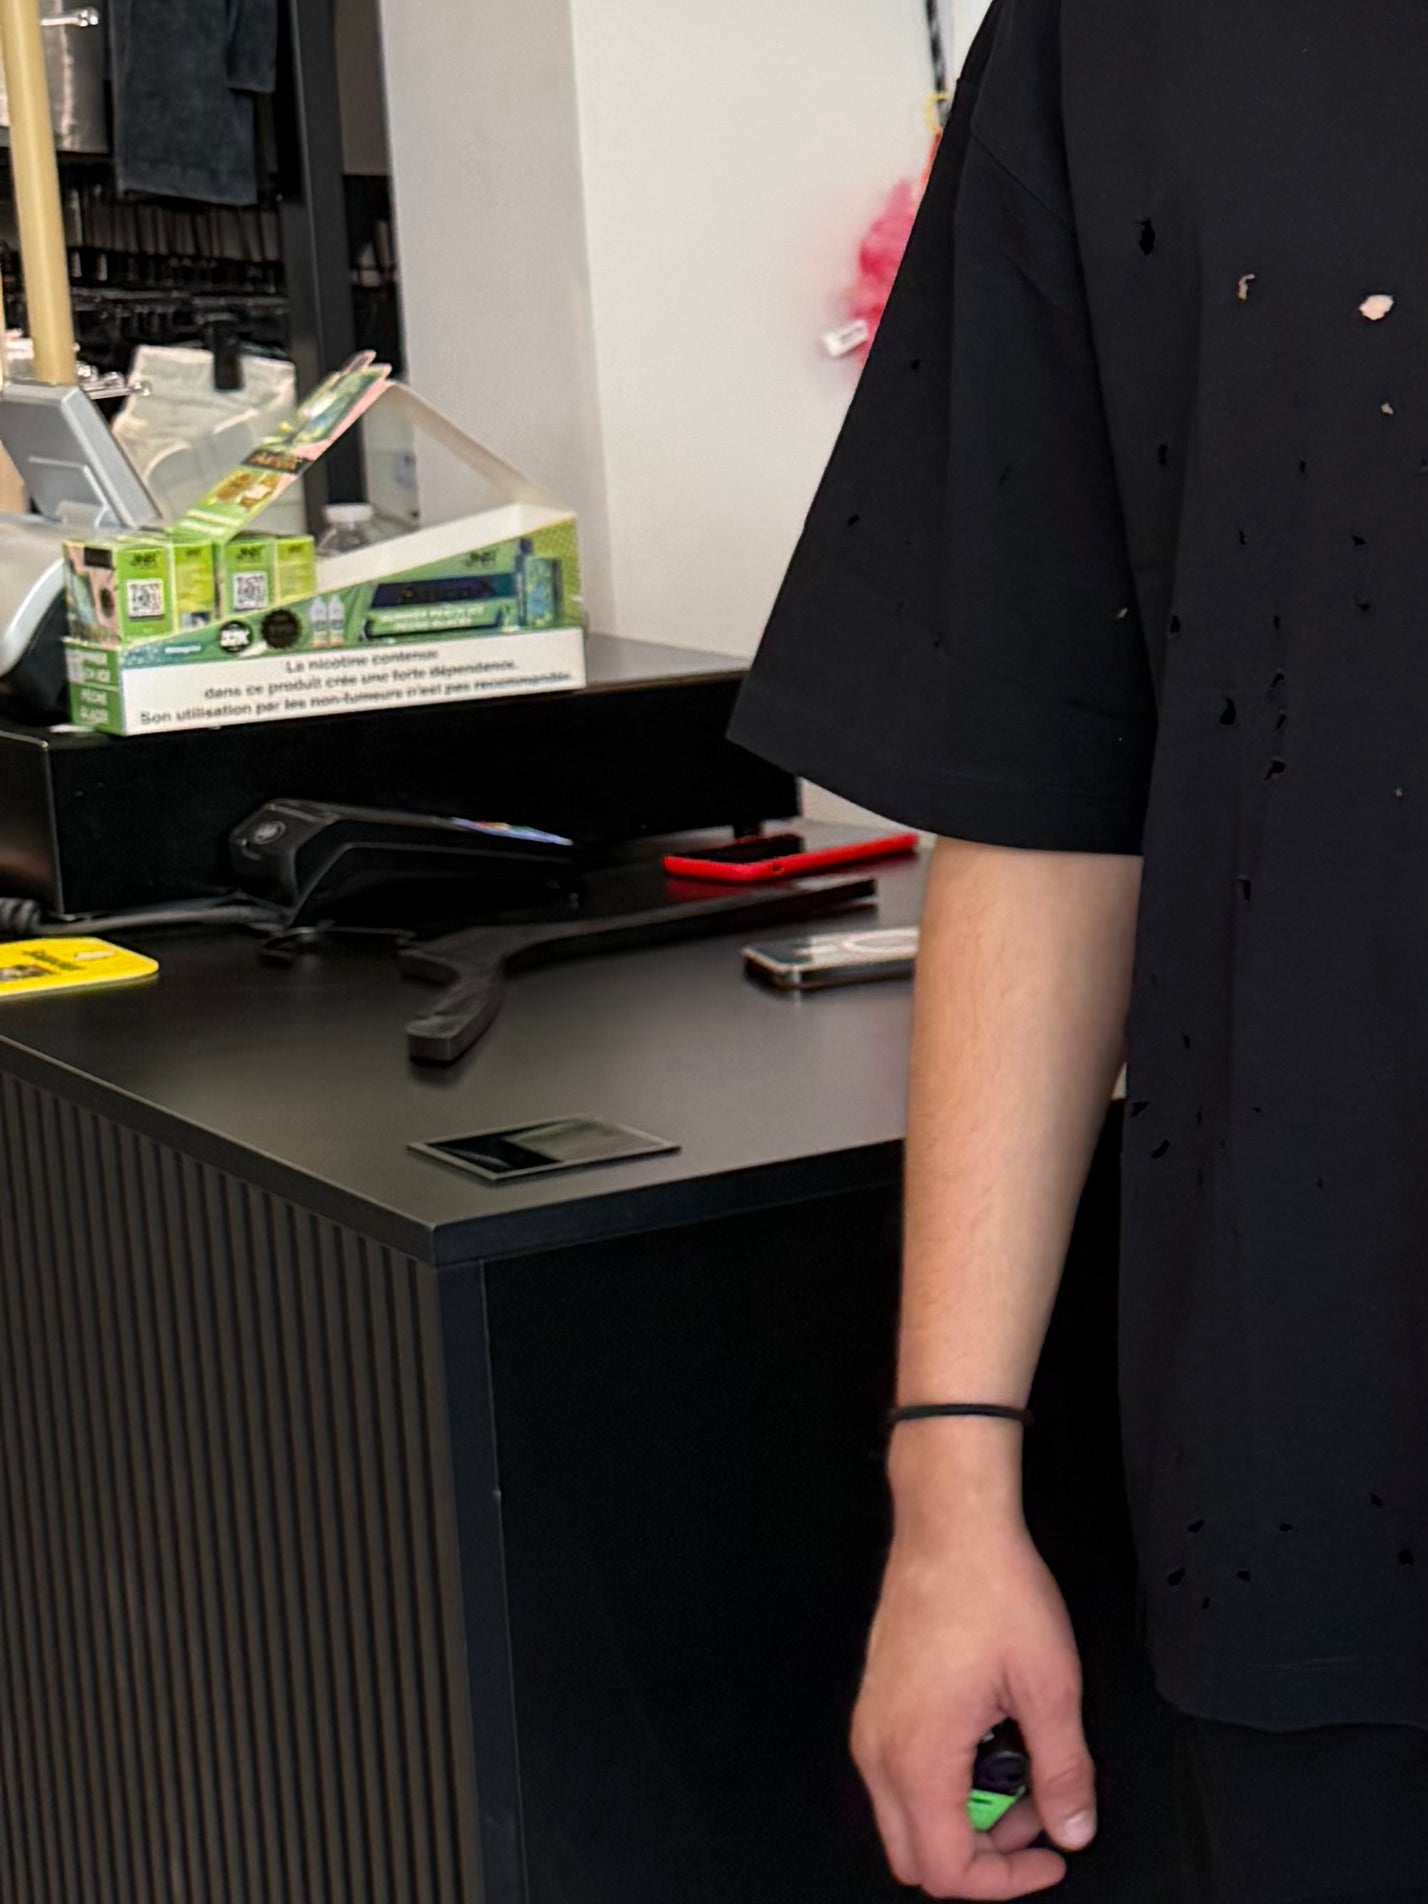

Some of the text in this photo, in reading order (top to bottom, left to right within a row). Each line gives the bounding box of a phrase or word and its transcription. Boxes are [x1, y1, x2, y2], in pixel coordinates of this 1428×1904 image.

[286, 659, 305, 674] La
[309, 655, 369, 671] nicotine
[204, 686, 242, 701] dans
[246, 685, 264, 696] ce
[268, 675, 322, 698] produit
[141, 709, 172, 726] Son
[176, 701, 251, 724] utilisation
[255, 700, 279, 716] par
[284, 697, 307, 710] les
